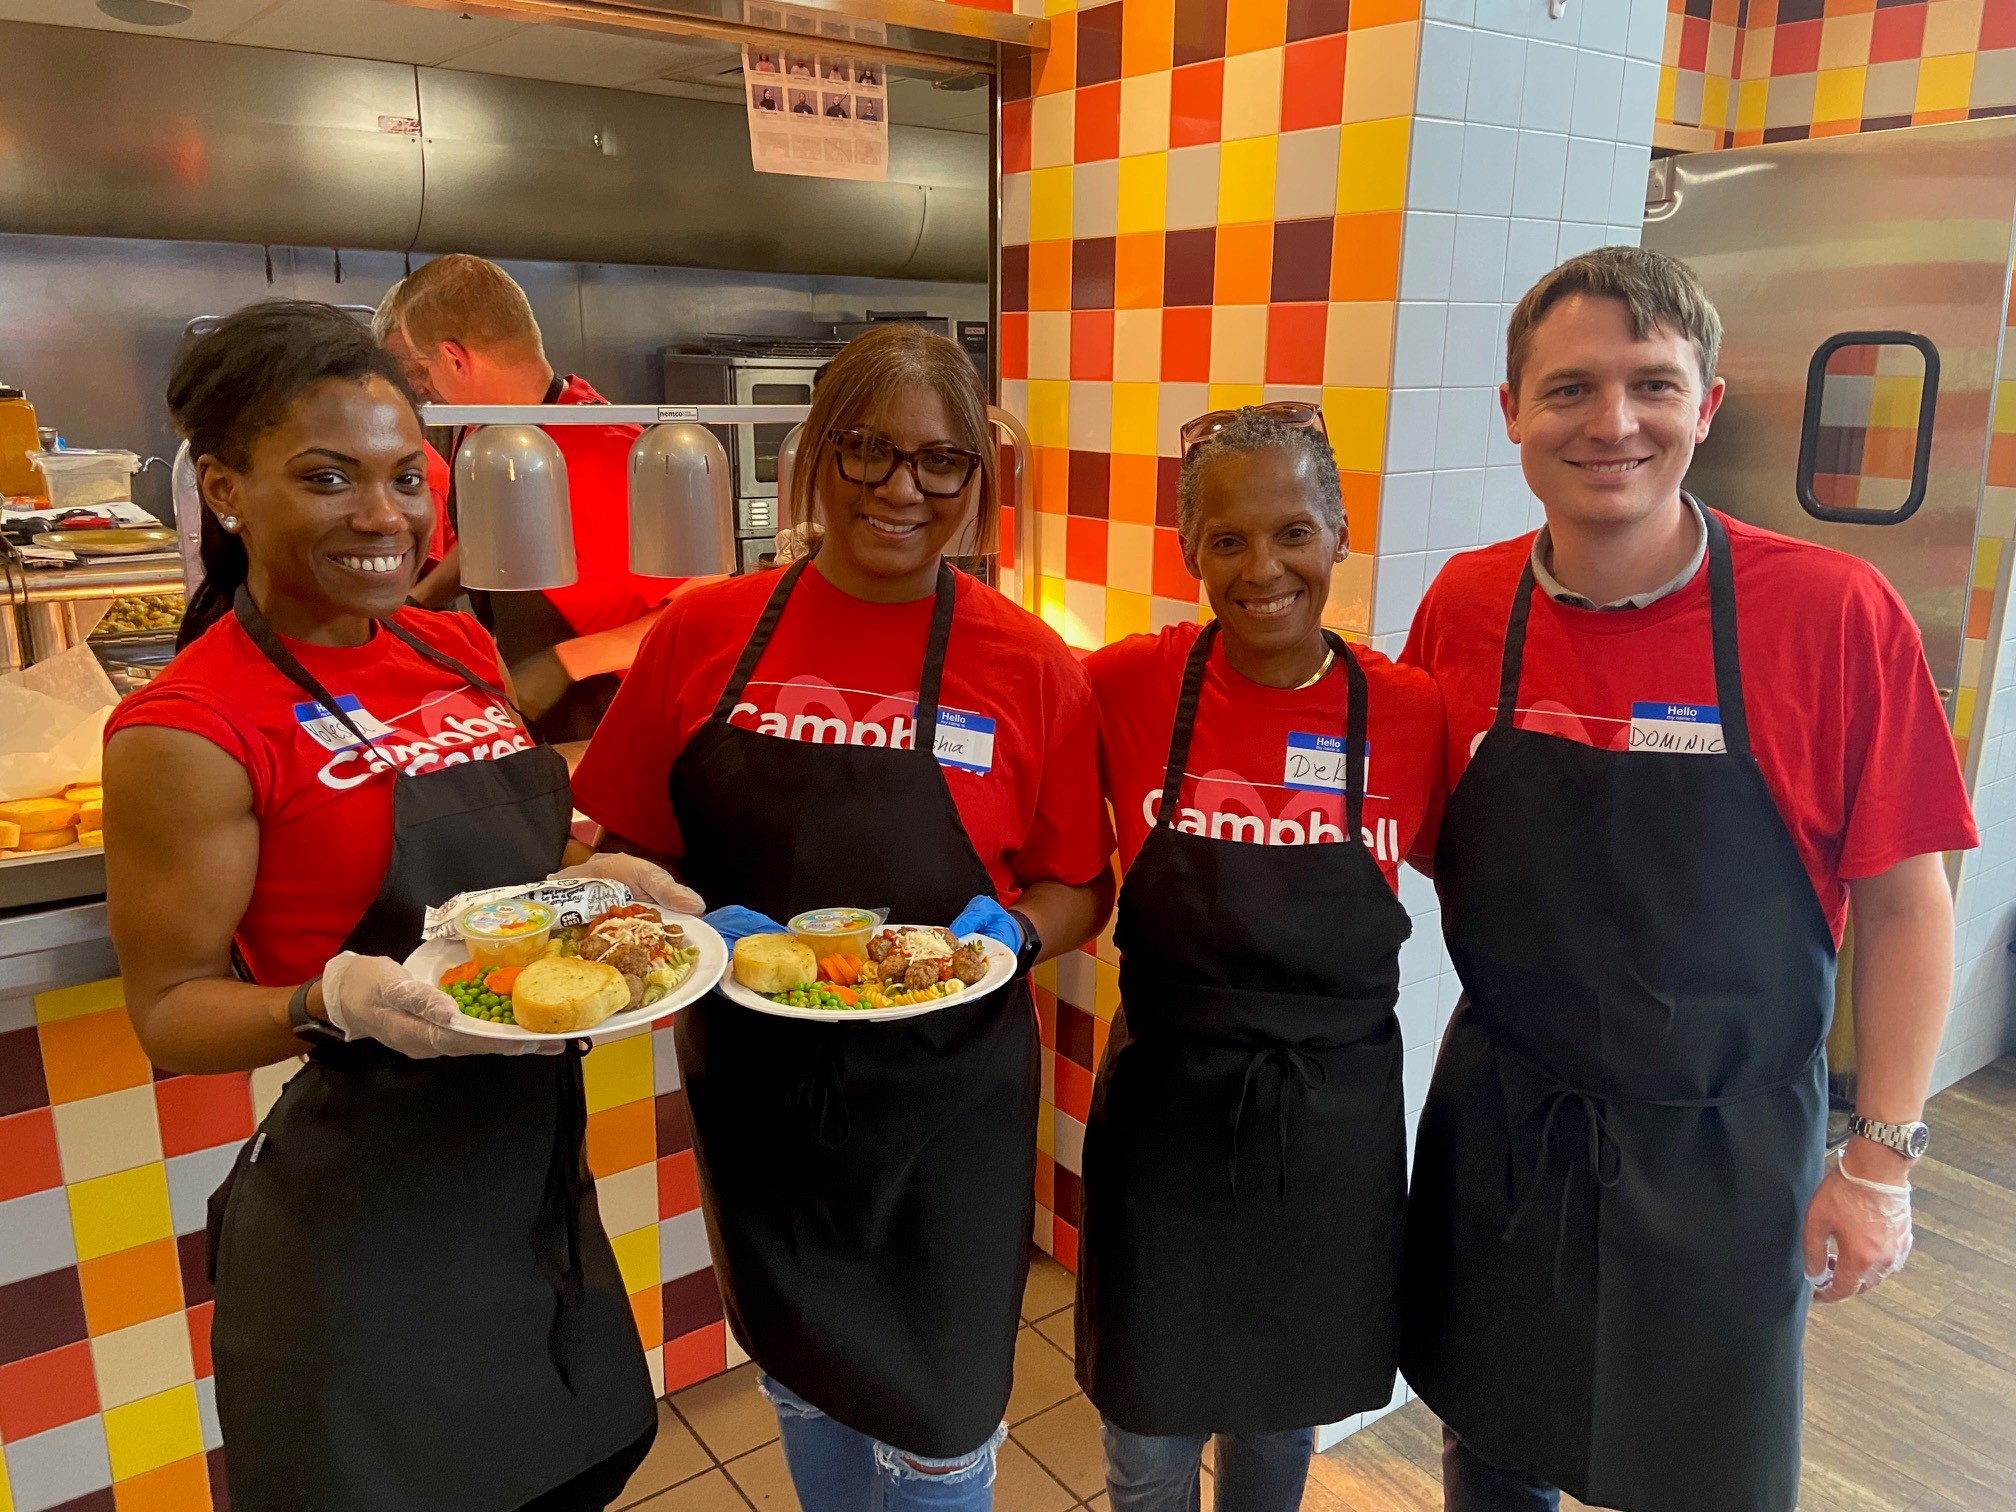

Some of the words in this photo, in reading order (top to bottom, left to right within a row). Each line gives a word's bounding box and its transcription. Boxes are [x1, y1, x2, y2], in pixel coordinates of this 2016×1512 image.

[1667, 705, 1698, 717] Hello
[941, 711, 966, 724] Hello
[1316, 736, 1341, 748] Hello
[1629, 726, 1726, 752] DOMINIC
